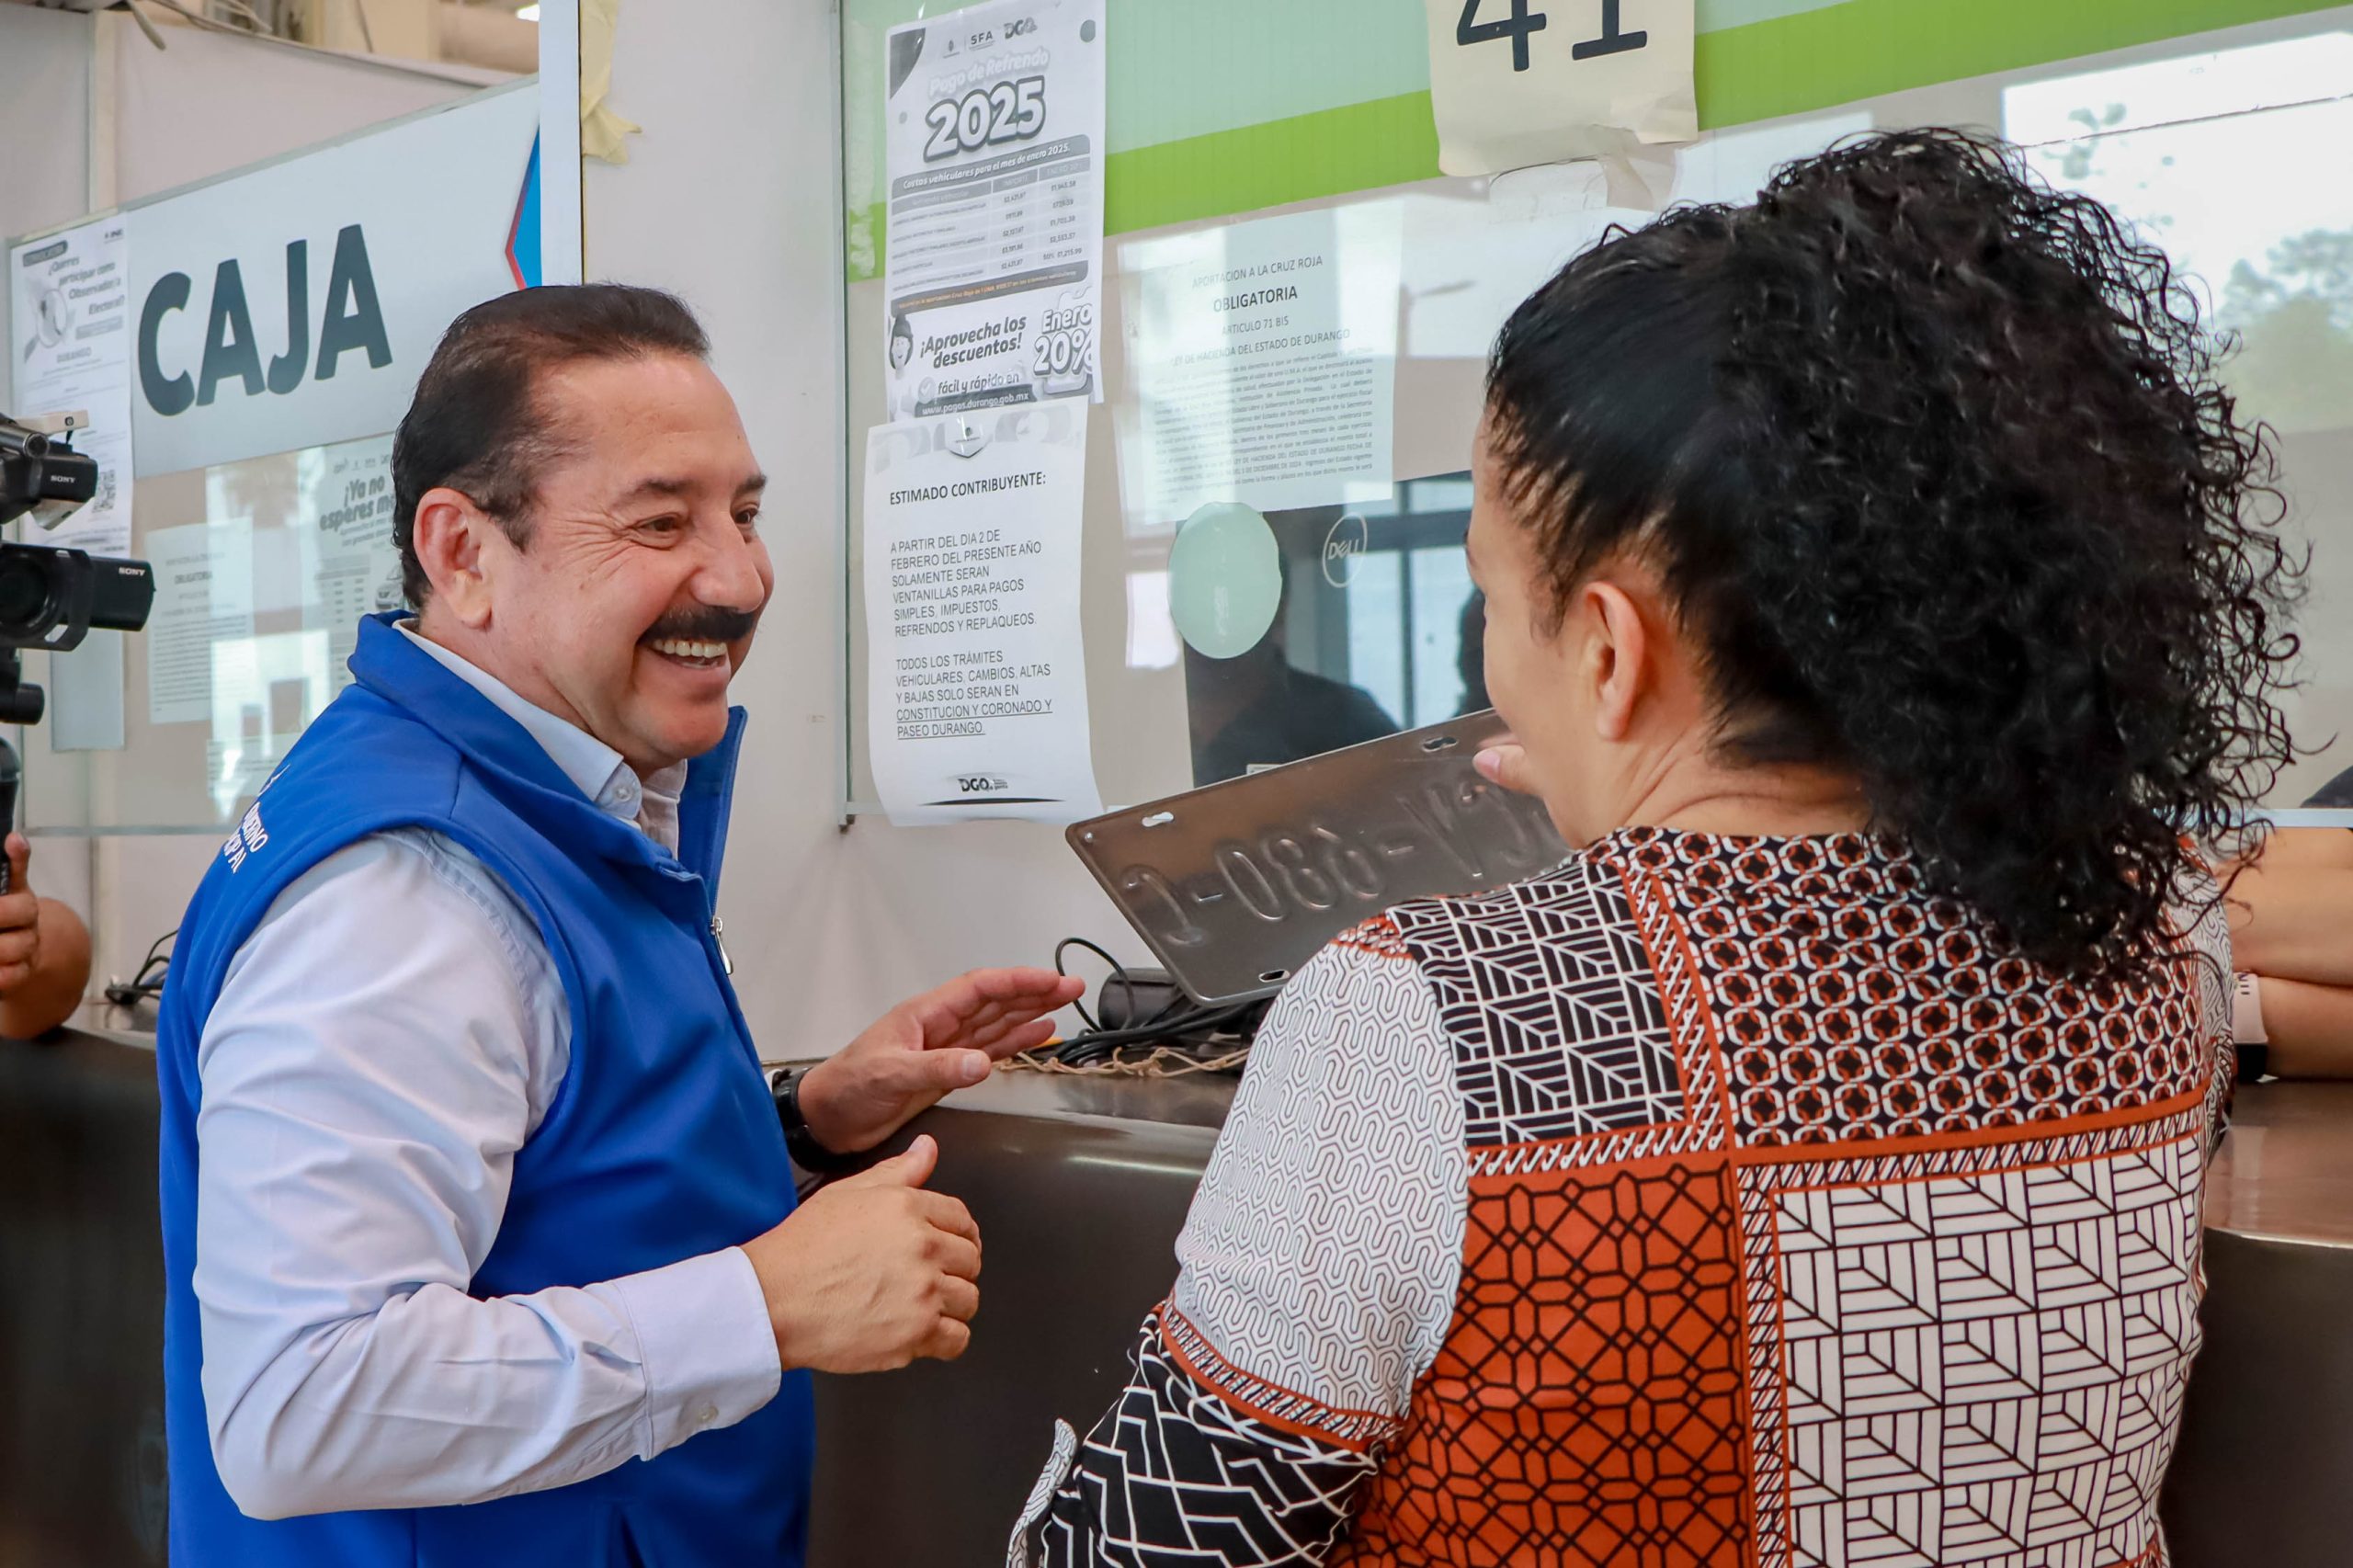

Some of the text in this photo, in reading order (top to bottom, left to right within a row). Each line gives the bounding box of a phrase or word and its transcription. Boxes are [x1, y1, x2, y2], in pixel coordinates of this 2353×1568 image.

[971, 30, 993, 45] SFA
[1457, 0, 1647, 72] 41
[986, 47, 1050, 77] Refrendo
[923, 75, 1046, 163] 2025
[904, 177, 927, 189] Costos
[974, 165, 992, 176] para
[993, 162, 1000, 171] el
[1000, 160, 1016, 169] mes
[1017, 155, 1026, 165] de
[1027, 150, 1046, 161] enero
[1192, 256, 1323, 290] APORTACION A LA CRUZ ROJA
[1213, 286, 1298, 312] OBLIGATORIA
[138, 224, 393, 416] CAJA
[1222, 315, 1290, 336] ARTICULO 71 BIS
[920, 315, 1027, 359] ¡Aprovecha los
[1238, 345, 1254, 356] DEL
[1255, 338, 1288, 353] ESTADO
[1290, 336, 1302, 347] DE
[1304, 328, 1350, 346] DURANGO
[933, 333, 1023, 369] descuentos!
[938, 377, 960, 394] fácil
[971, 372, 1004, 392] rápido
[922, 391, 1029, 415] www.pagos.durango.gob.mx
[51, 474, 75, 483] SONY
[369, 475, 385, 496] no
[890, 472, 1046, 505] ESTIMADO CONTRIBUYENTE:
[319, 500, 374, 532] esperes
[891, 529, 1000, 554] A PARTIR DEL DIA 2 DE
[1327, 539, 1359, 560] DELL
[891, 540, 1041, 571] FEBRERO DEL PRESENTE AÑO
[119, 566, 145, 576] SONY
[892, 566, 990, 587] SOLAMENTE SERAN
[893, 578, 1025, 604] VENTANILLAS PARA PAGOS
[894, 599, 1000, 621] SIMPLES, IMPUESTOS,
[895, 612, 1037, 637] REFRENDOS Y REPLAQUEOS.
[896, 650, 1004, 670] TODOS LOS TRÁMITES
[896, 664, 1051, 687] VEHICULARES, CAMBIOS, ALTAS
[896, 684, 1019, 704] Y BAJAS SOLO SERAN EN
[896, 699, 1052, 722] CONSTITUCION Y CORONADO Y
[897, 722, 983, 737] PASEO DURANGO
[958, 778, 990, 792] DGO
